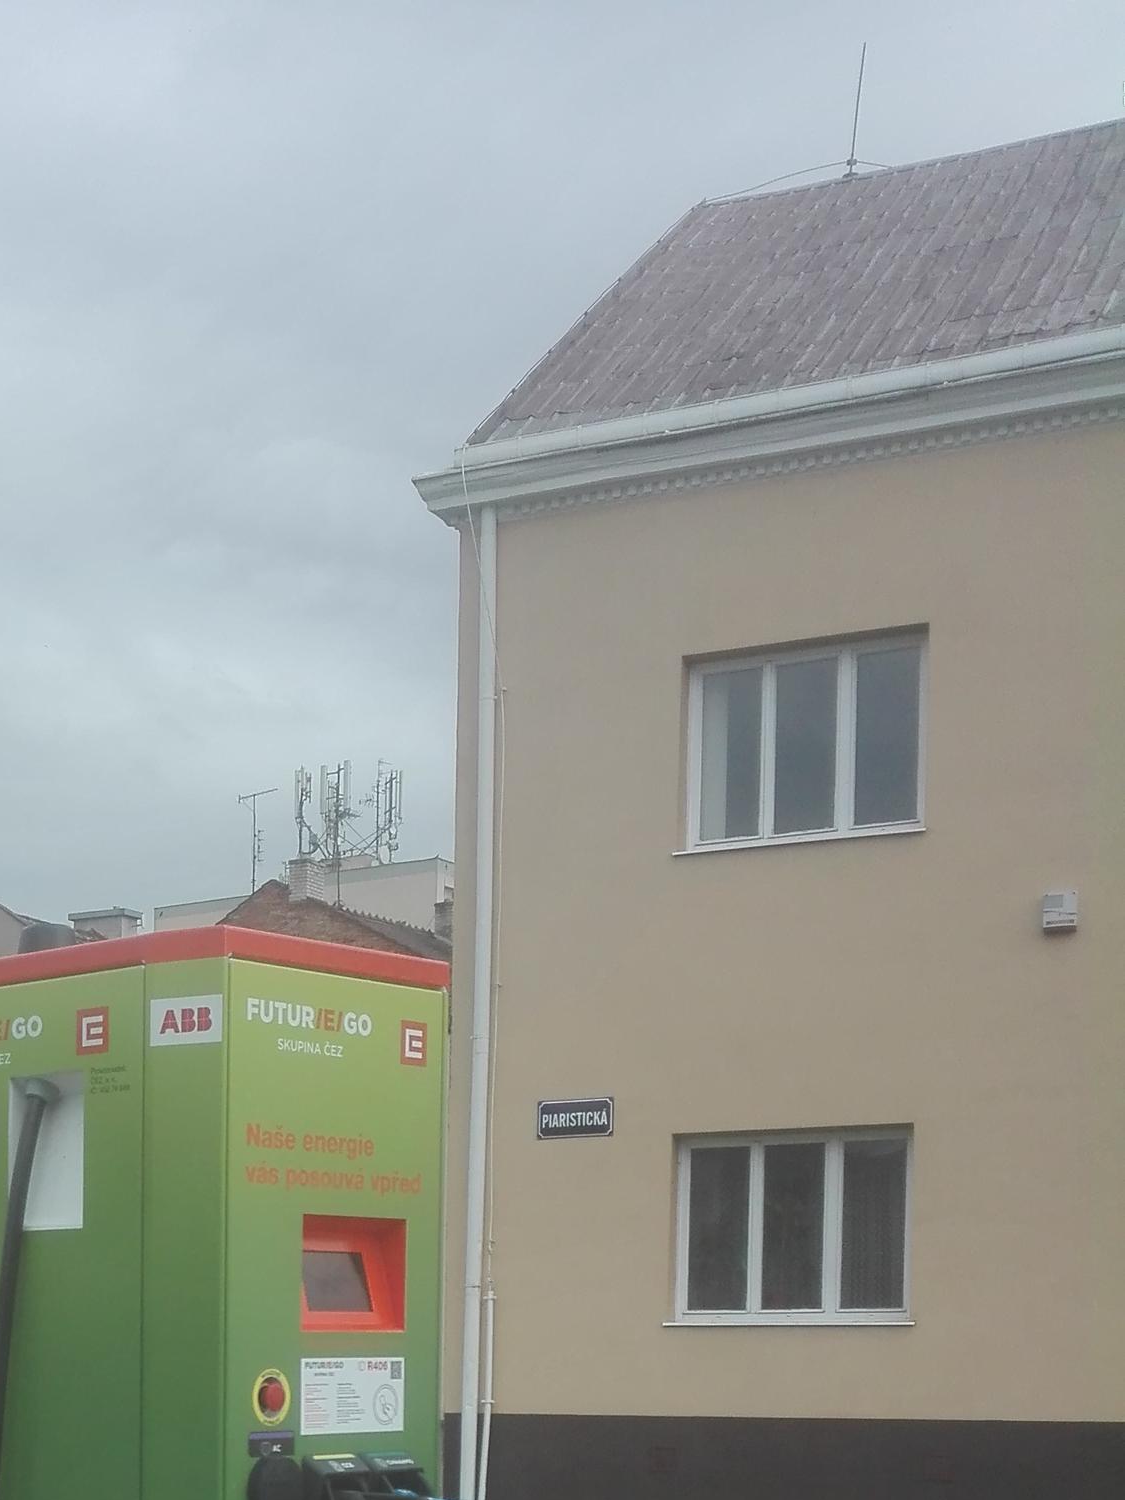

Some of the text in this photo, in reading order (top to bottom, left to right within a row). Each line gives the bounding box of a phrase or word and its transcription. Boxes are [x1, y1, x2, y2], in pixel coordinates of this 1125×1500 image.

[159, 1006, 213, 1035] ABB
[277, 1038, 344, 1057] SKUPINA ČEZ
[542, 1107, 608, 1129] PIARISTICKÁ
[246, 1123, 375, 1161] Naše energie
[245, 1161, 423, 1196] vás posouvá vpřed
